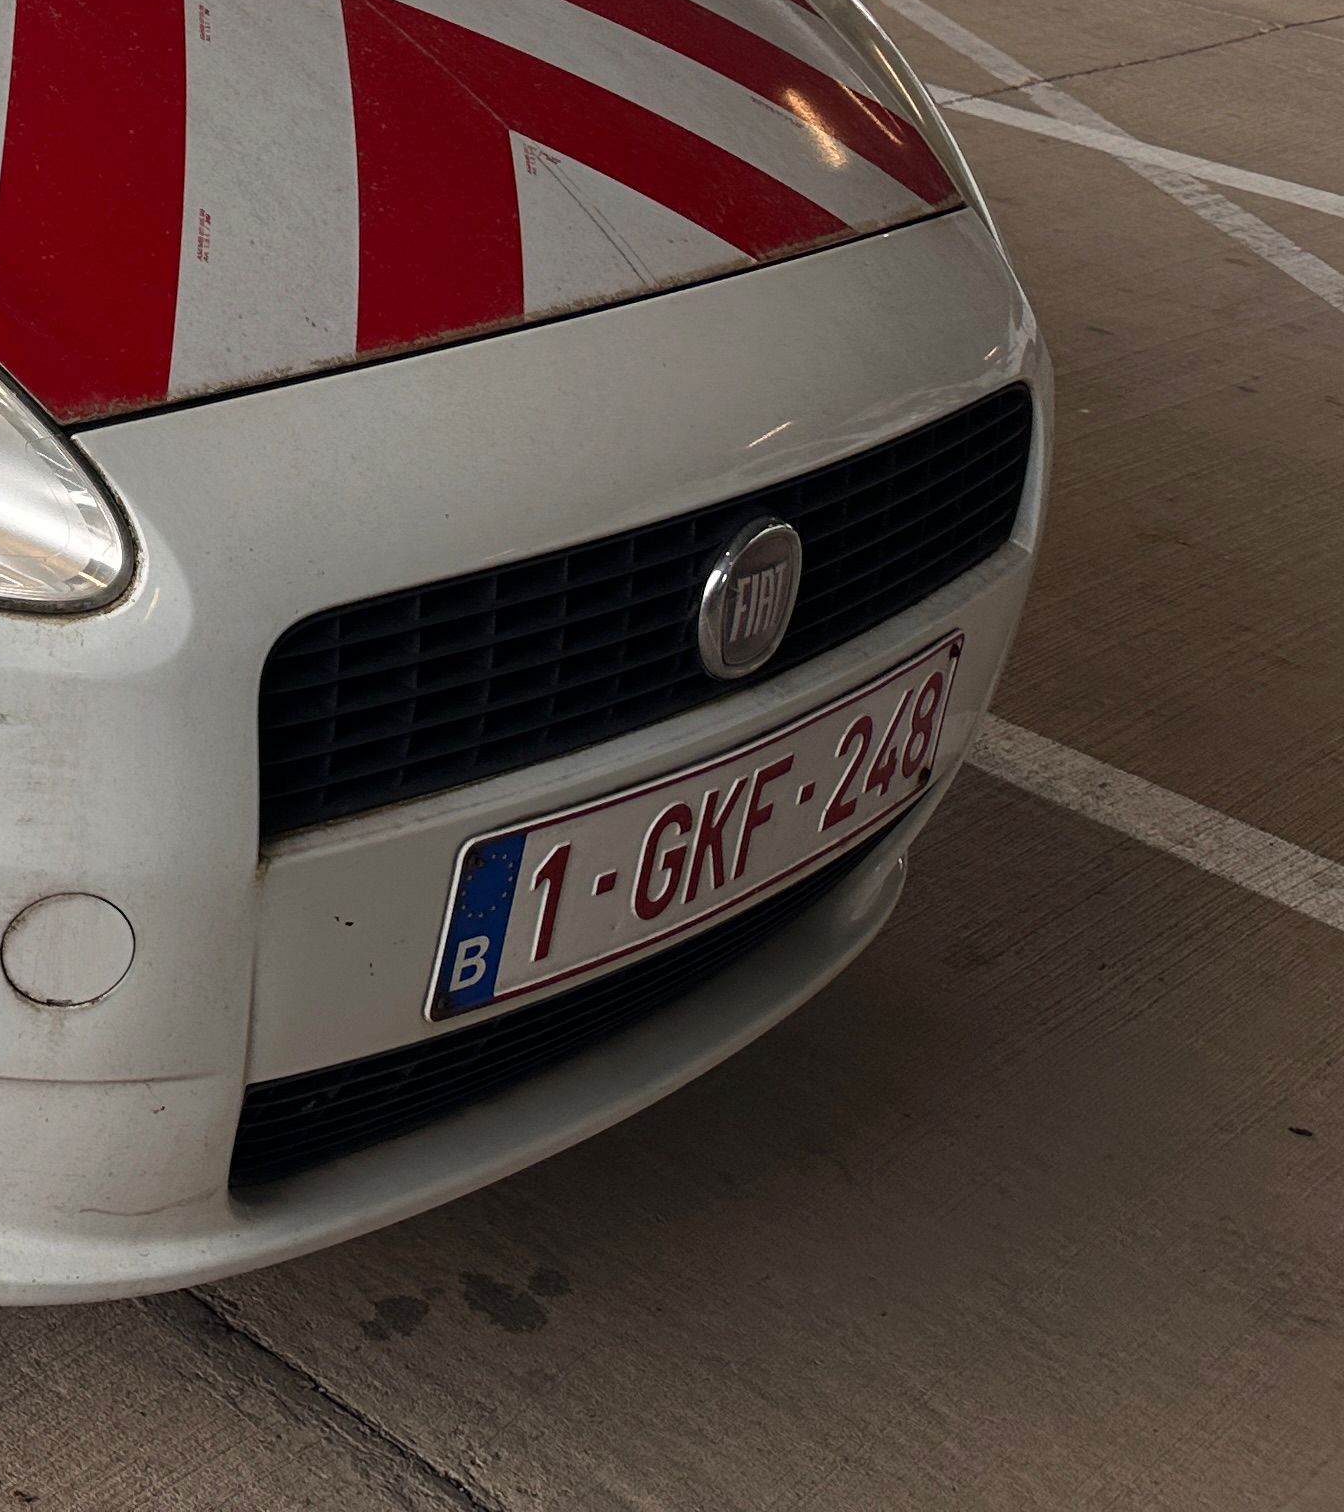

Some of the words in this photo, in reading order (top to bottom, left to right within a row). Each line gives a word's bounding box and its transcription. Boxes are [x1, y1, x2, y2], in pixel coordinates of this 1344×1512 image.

[729, 560, 787, 643] FIAT
[529, 672, 943, 963] 1-GKF-248
[450, 935, 488, 990] B
